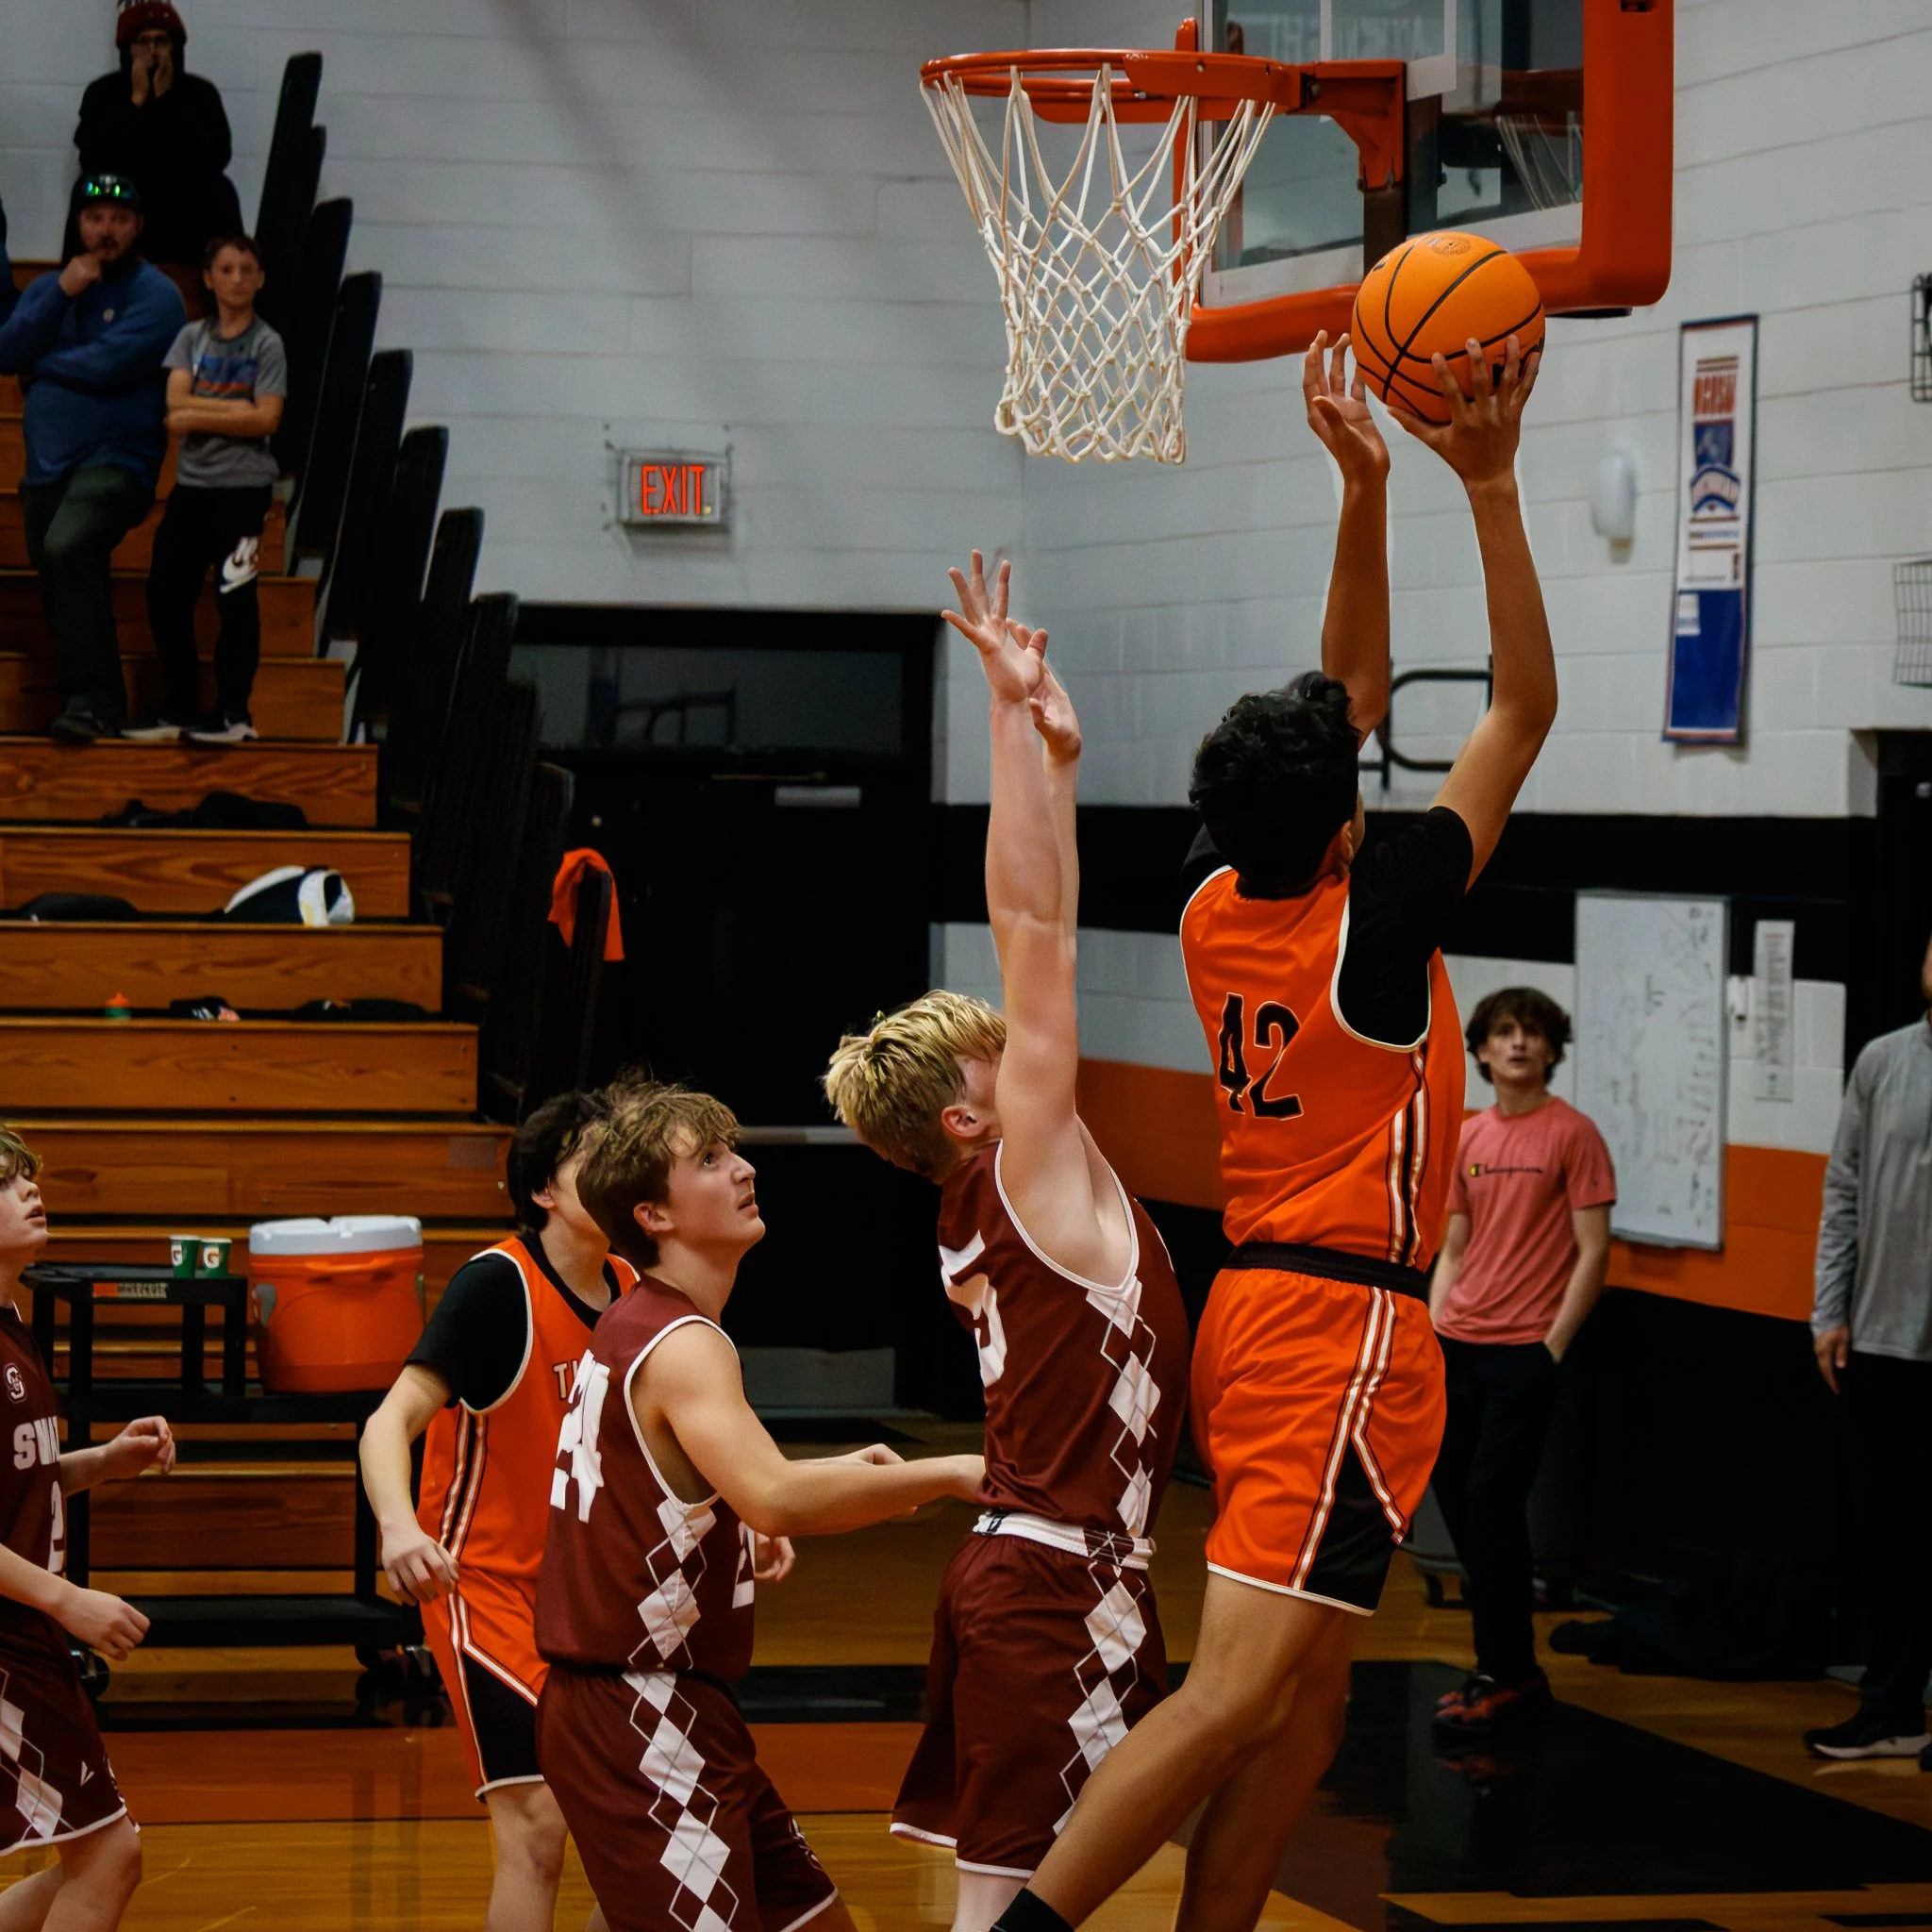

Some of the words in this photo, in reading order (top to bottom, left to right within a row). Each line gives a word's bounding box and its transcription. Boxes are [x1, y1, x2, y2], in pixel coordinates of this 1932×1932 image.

[641, 464, 706, 515] EXIT
[1218, 992, 1305, 1121] 42
[550, 1348, 611, 1524] 24
